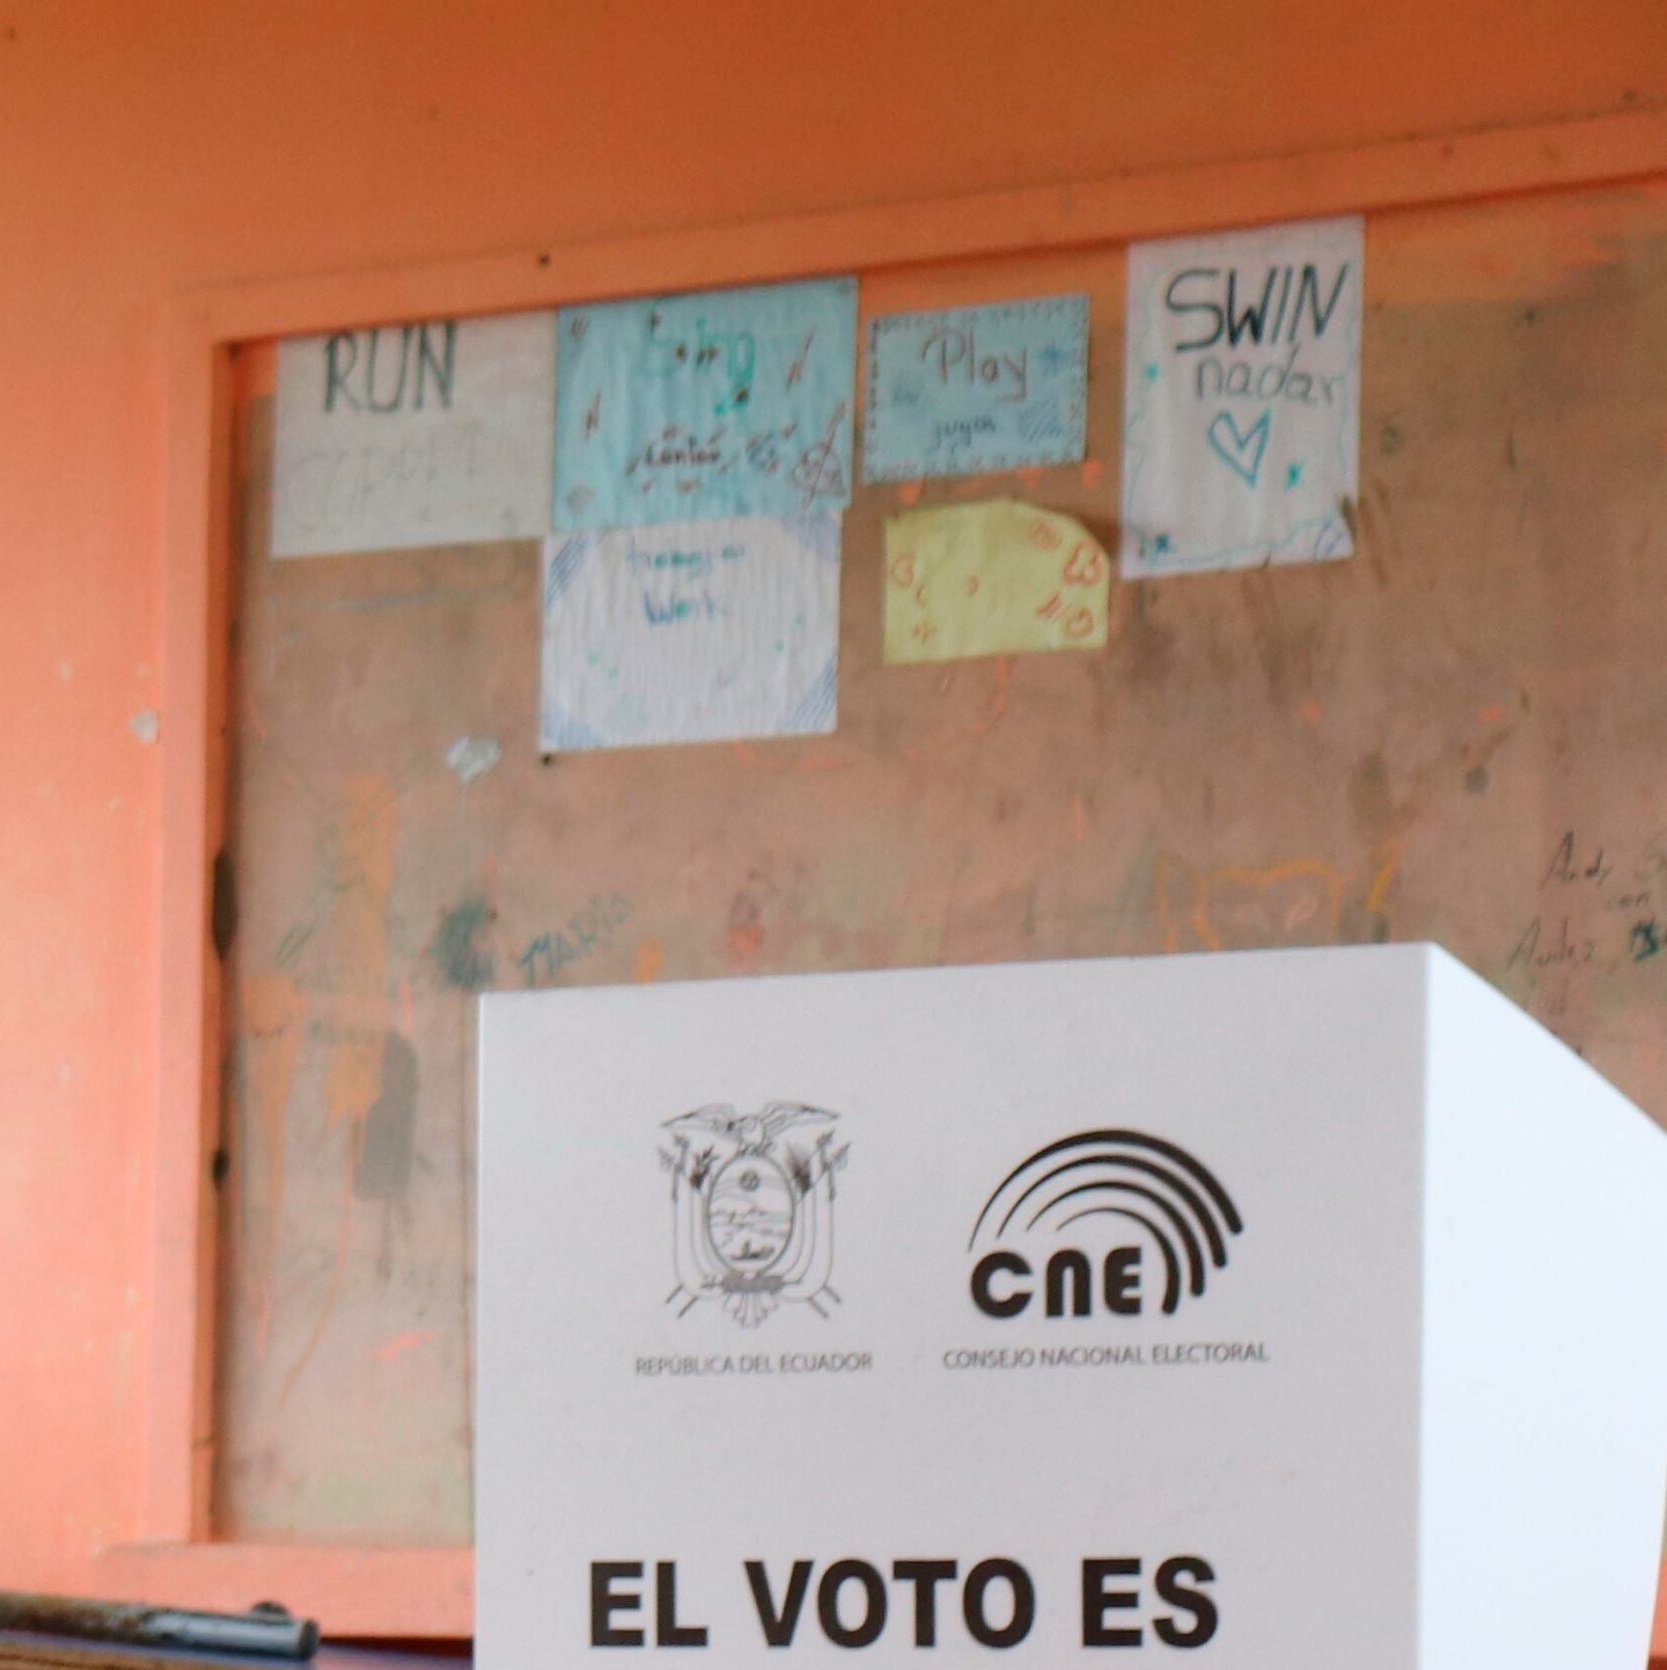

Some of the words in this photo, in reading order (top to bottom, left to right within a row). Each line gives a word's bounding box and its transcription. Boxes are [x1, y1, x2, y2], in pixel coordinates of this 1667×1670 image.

[1165, 262, 1350, 354] SWIN
[323, 320, 458, 414] RUN
[920, 325, 1028, 403] Play
[739, 1354, 773, 1375] DEL
[779, 1351, 873, 1374] ECUADOR
[942, 1349, 1035, 1370] CONSEJO
[1039, 1345, 1147, 1367] NACIONAL
[1151, 1341, 1271, 1366] ELECTORAL
[589, 1559, 709, 1649] EL
[743, 1557, 1036, 1650] VOTO
[1080, 1555, 1220, 1650] ES
